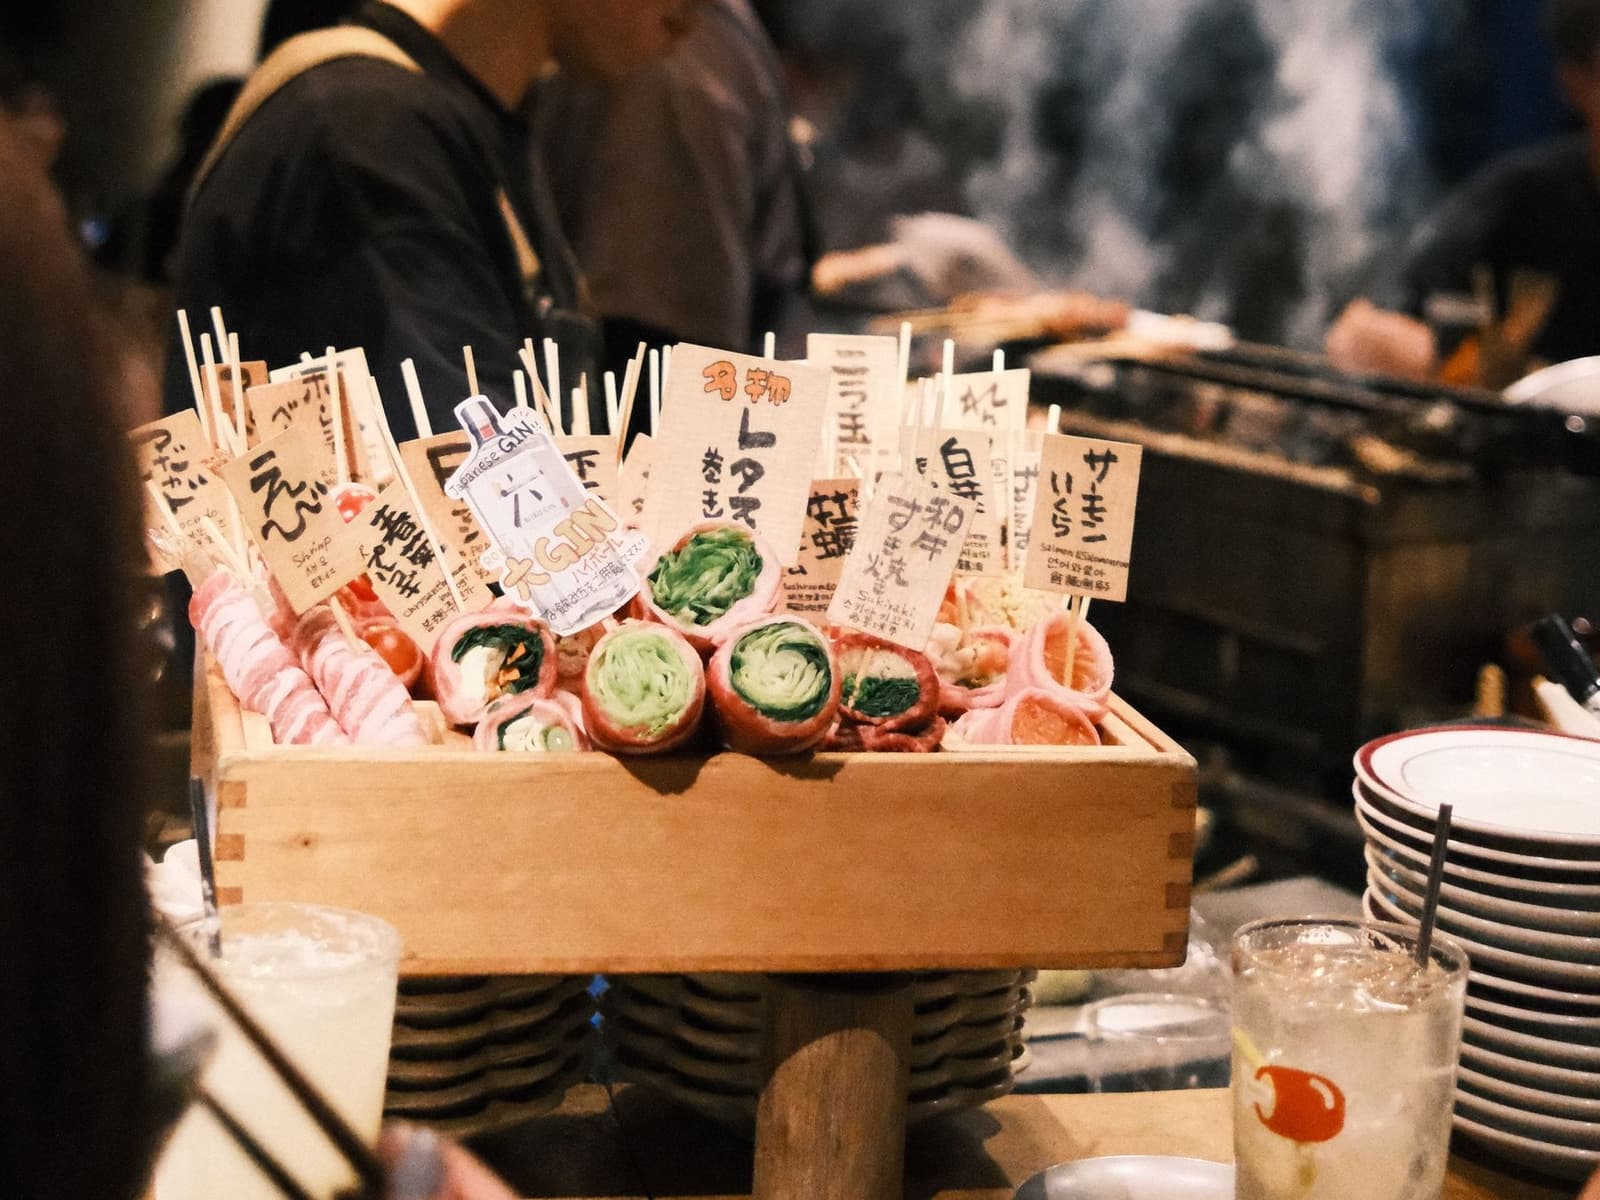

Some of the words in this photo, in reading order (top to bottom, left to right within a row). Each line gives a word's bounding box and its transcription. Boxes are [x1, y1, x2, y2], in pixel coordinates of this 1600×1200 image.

[702, 360, 792, 406] 名物
[249, 450, 328, 542] えび
[449, 450, 500, 496] Japanese
[500, 469, 544, 528] 六
[701, 446, 725, 518] 巻き
[728, 407, 777, 529] レタス
[1081, 448, 1119, 542] サーモン
[910, 496, 964, 562] 和牛
[1051, 471, 1072, 537] いくら
[292, 536, 332, 567] Shrimp
